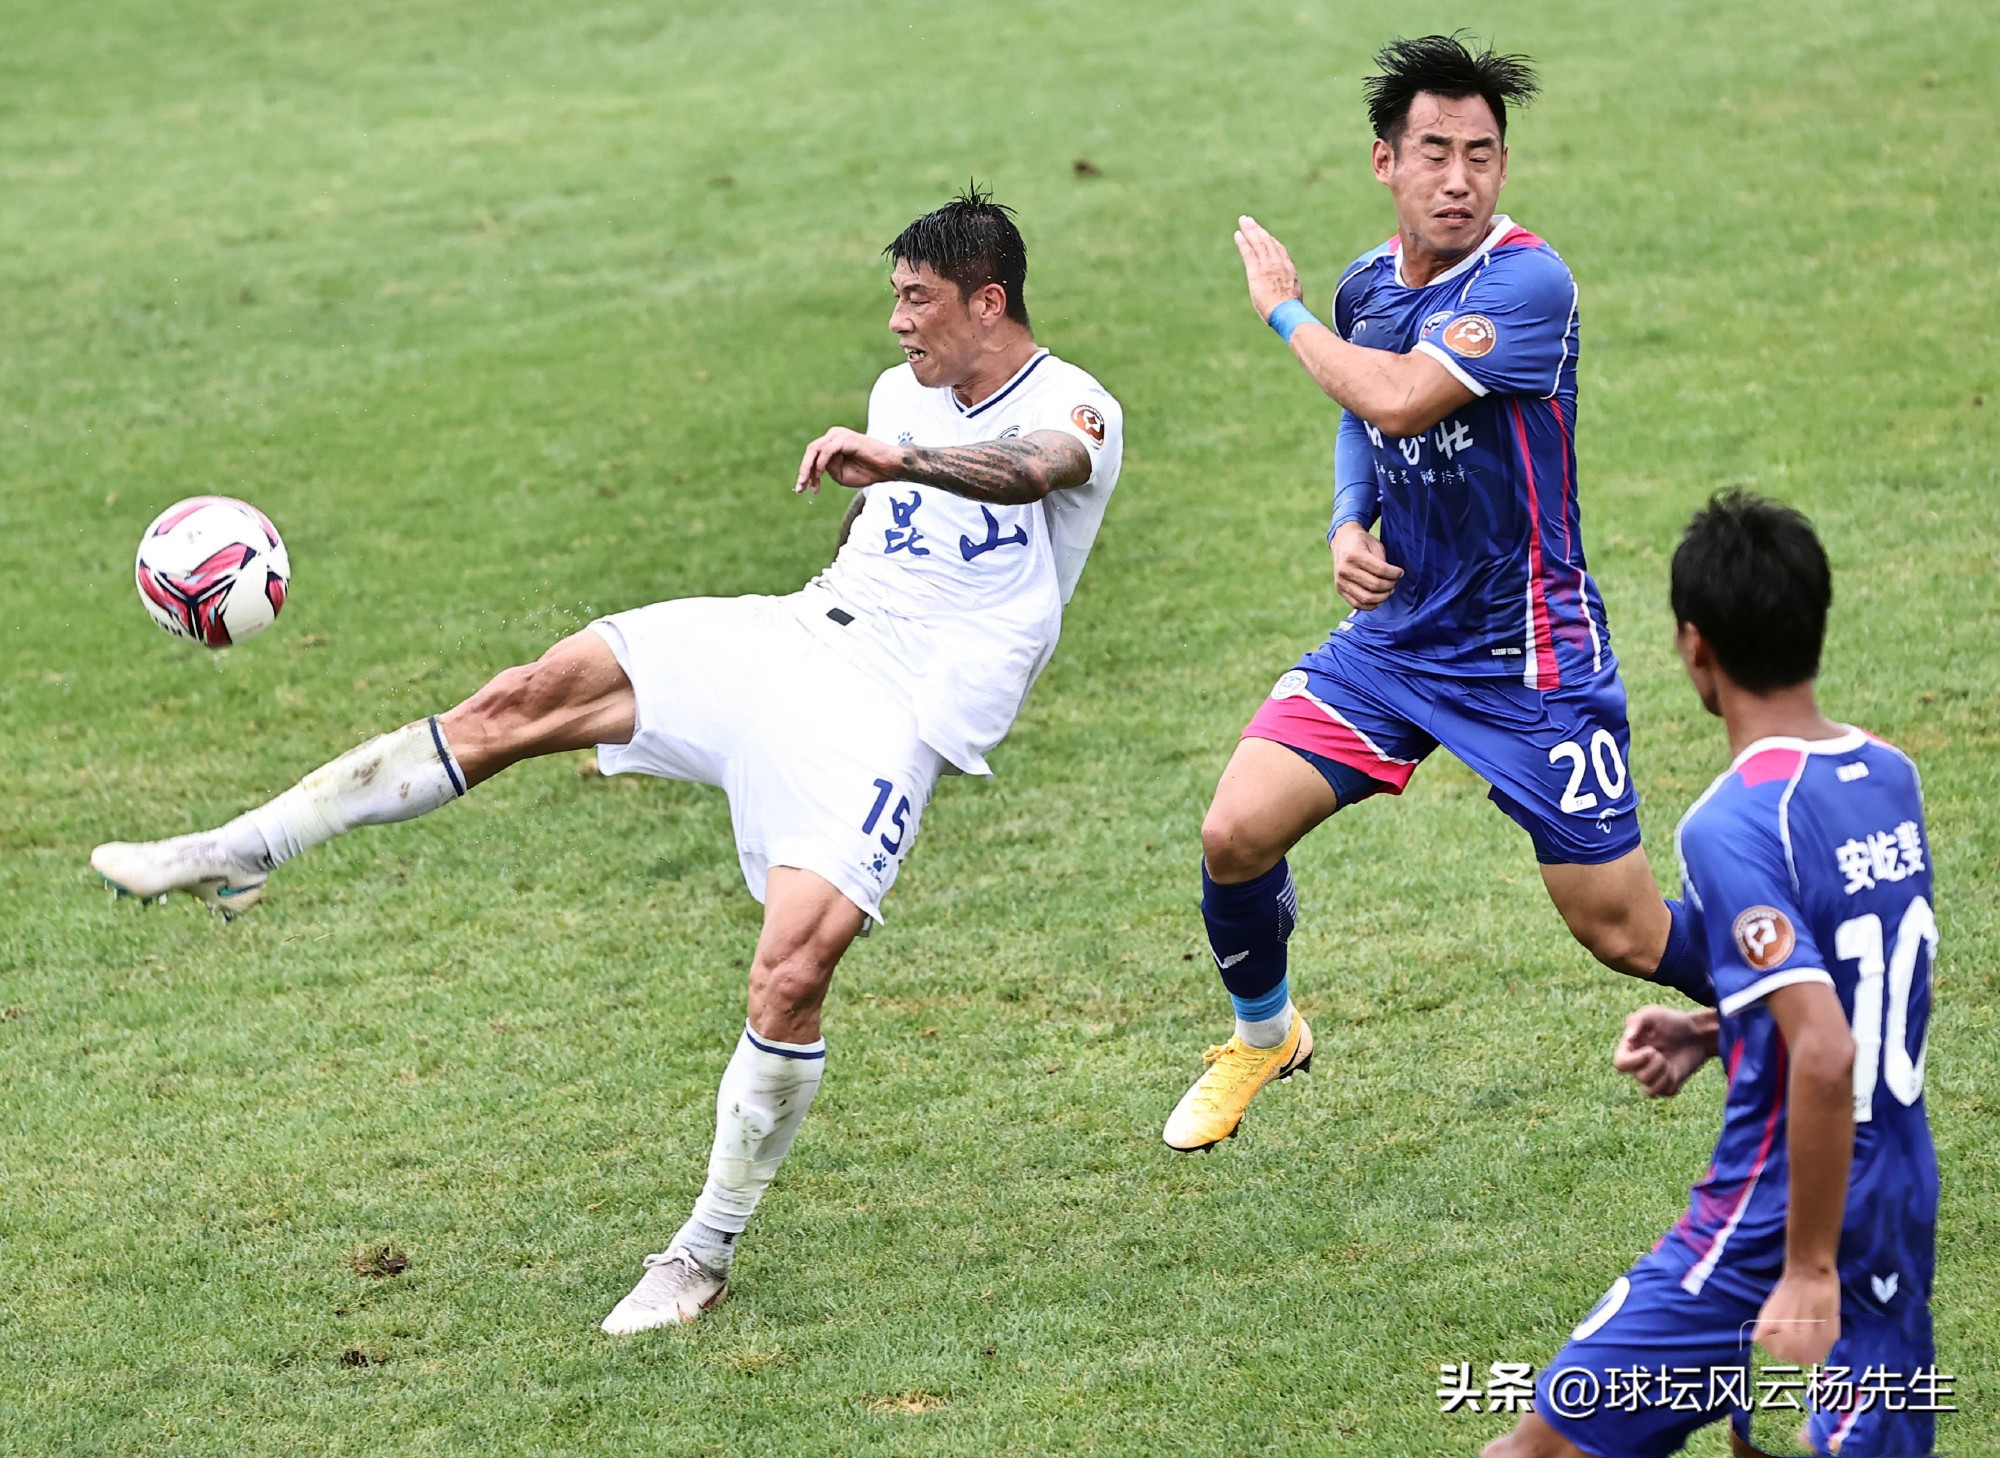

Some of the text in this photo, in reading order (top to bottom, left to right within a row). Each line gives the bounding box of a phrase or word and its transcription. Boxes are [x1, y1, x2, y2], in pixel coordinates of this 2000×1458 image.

[884, 490, 1028, 562] 昆山
[1549, 728, 1627, 814] 20
[862, 778, 911, 856] 15
[1834, 895, 1939, 1123] 10
